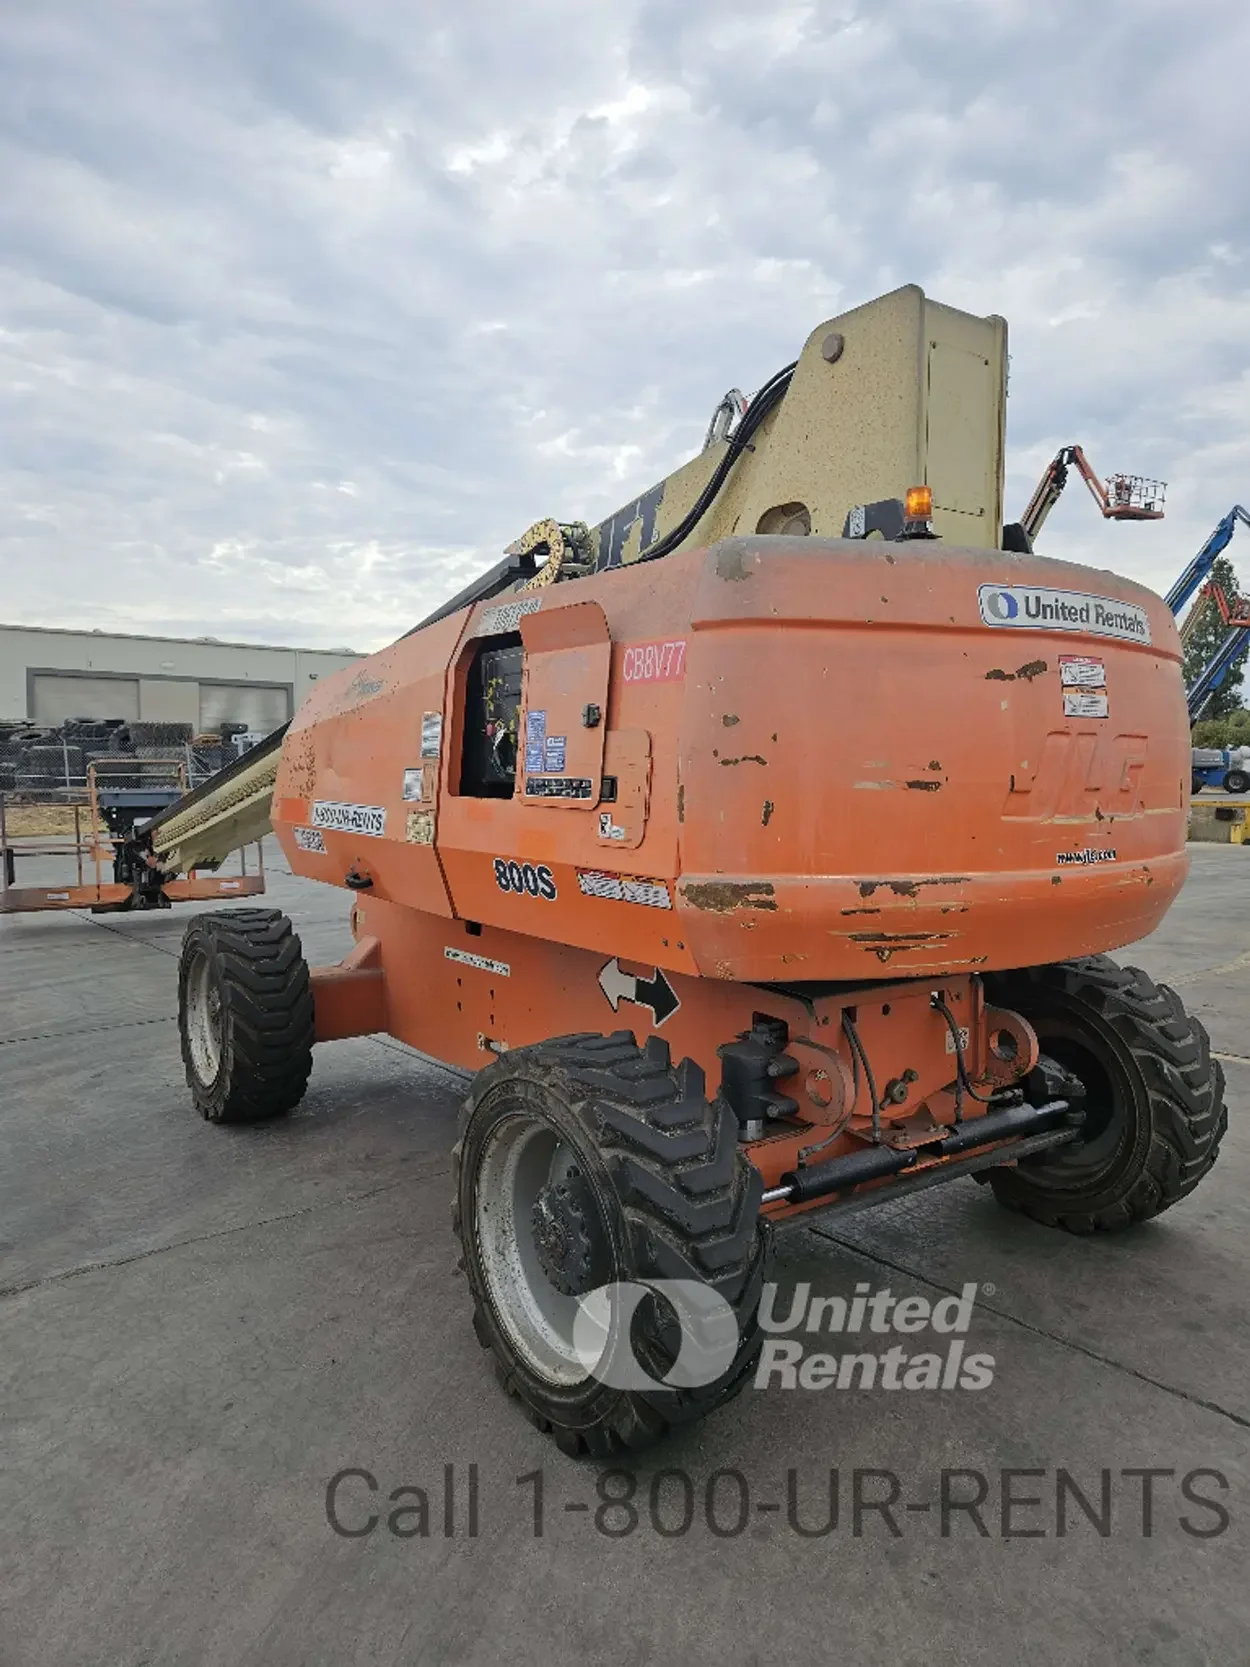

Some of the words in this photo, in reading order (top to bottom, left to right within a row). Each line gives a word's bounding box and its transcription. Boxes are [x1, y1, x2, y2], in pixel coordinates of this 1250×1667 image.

[1024, 595, 1090, 624] United
[1094, 603, 1146, 636] Rentals
[623, 641, 686, 681] CB8V77
[494, 858, 557, 901] 800S
